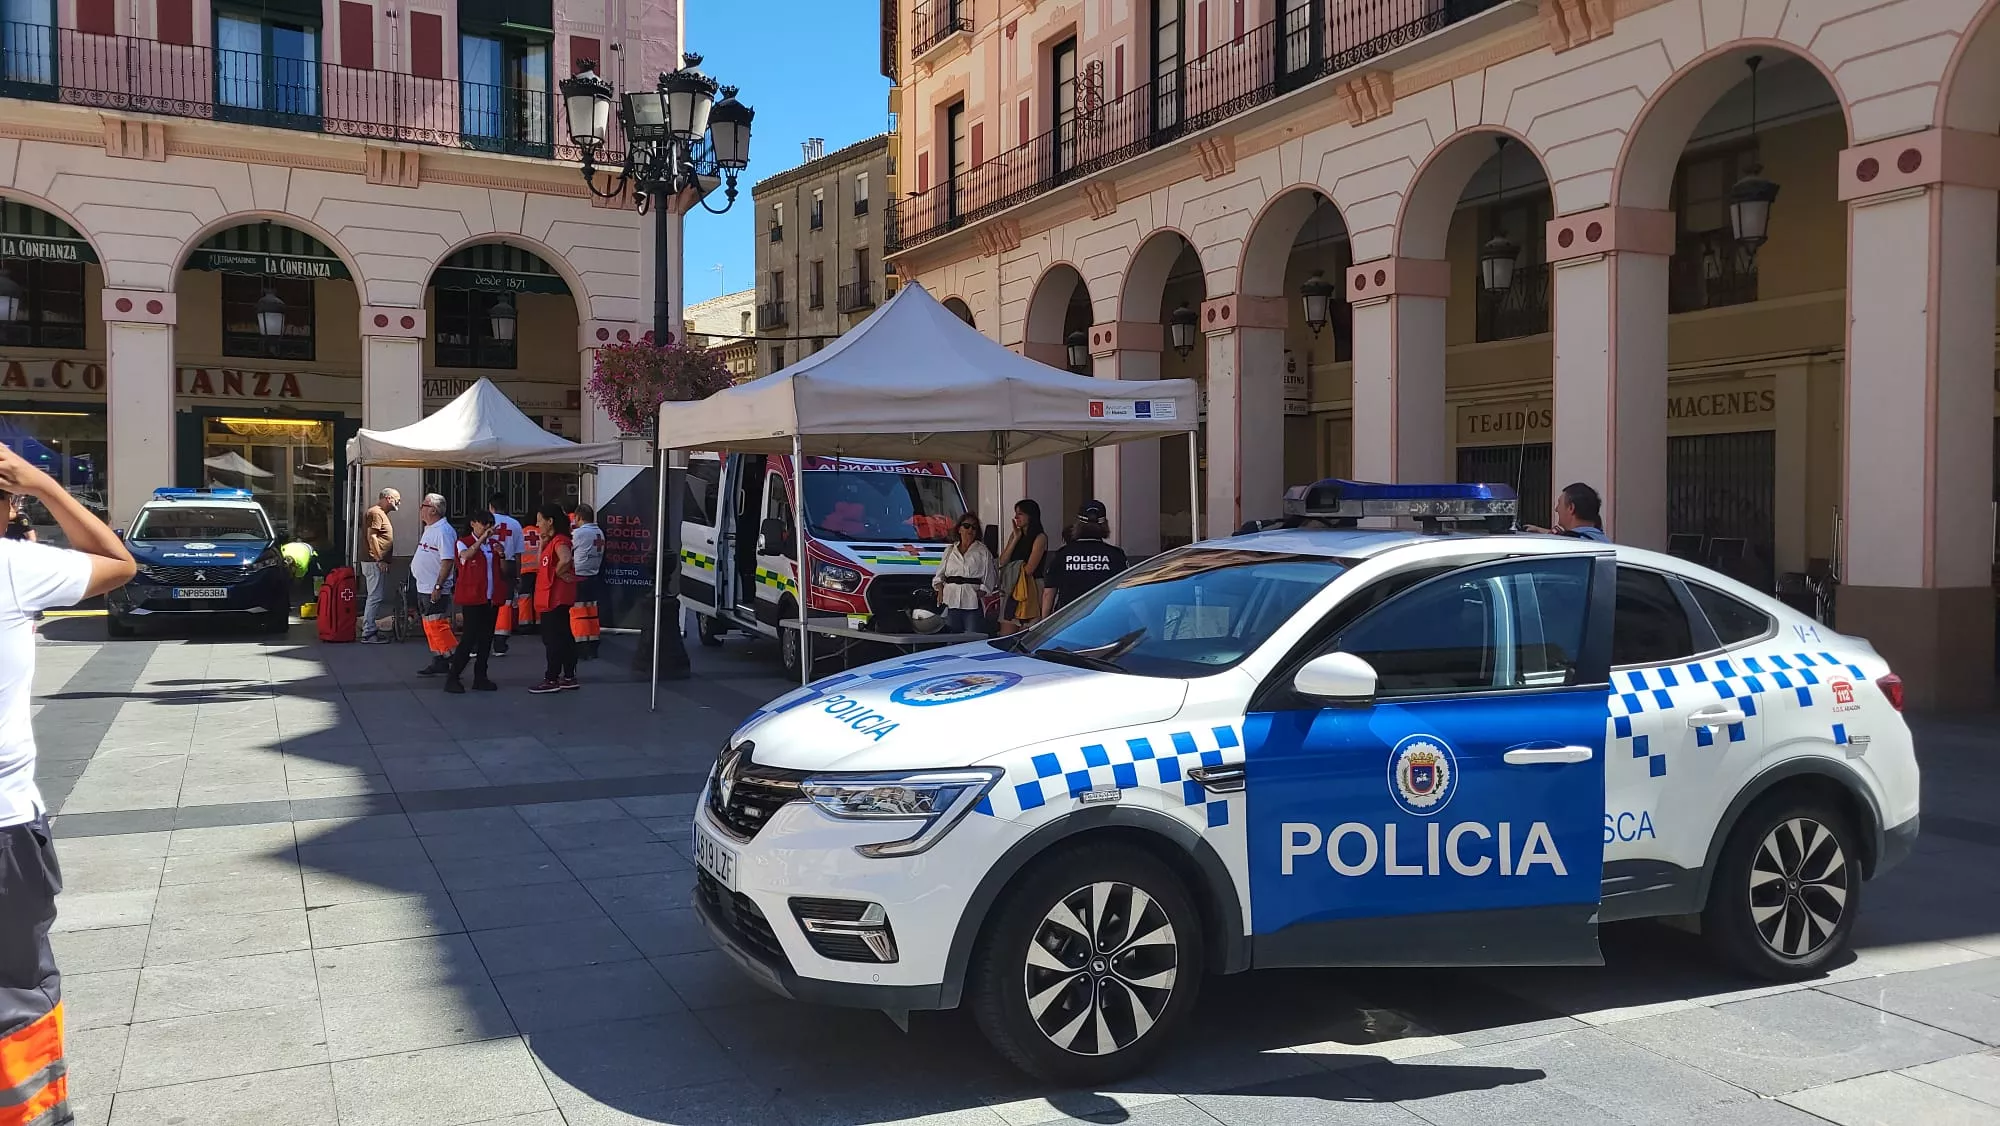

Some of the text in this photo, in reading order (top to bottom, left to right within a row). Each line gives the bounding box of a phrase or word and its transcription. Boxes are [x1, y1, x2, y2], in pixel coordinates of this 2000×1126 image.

[2, 239, 77, 260] LA CONFIANZA
[265, 257, 277, 273] LA
[280, 258, 331, 277] CONFIANZA
[475, 274, 525, 289] desde 1871
[1468, 389, 1776, 433] TEJIDOS MACENES
[606, 515, 641, 525] DE LA
[606, 541, 637, 551] PARA
[1065, 555, 1110, 563] POLICIA
[1065, 563, 1110, 571] HUESCA
[605, 569, 639, 577] NUESTRO
[1793, 624, 1821, 643] V-1
[813, 694, 900, 742] POLICIA
[1281, 822, 1568, 876] POLICIA
